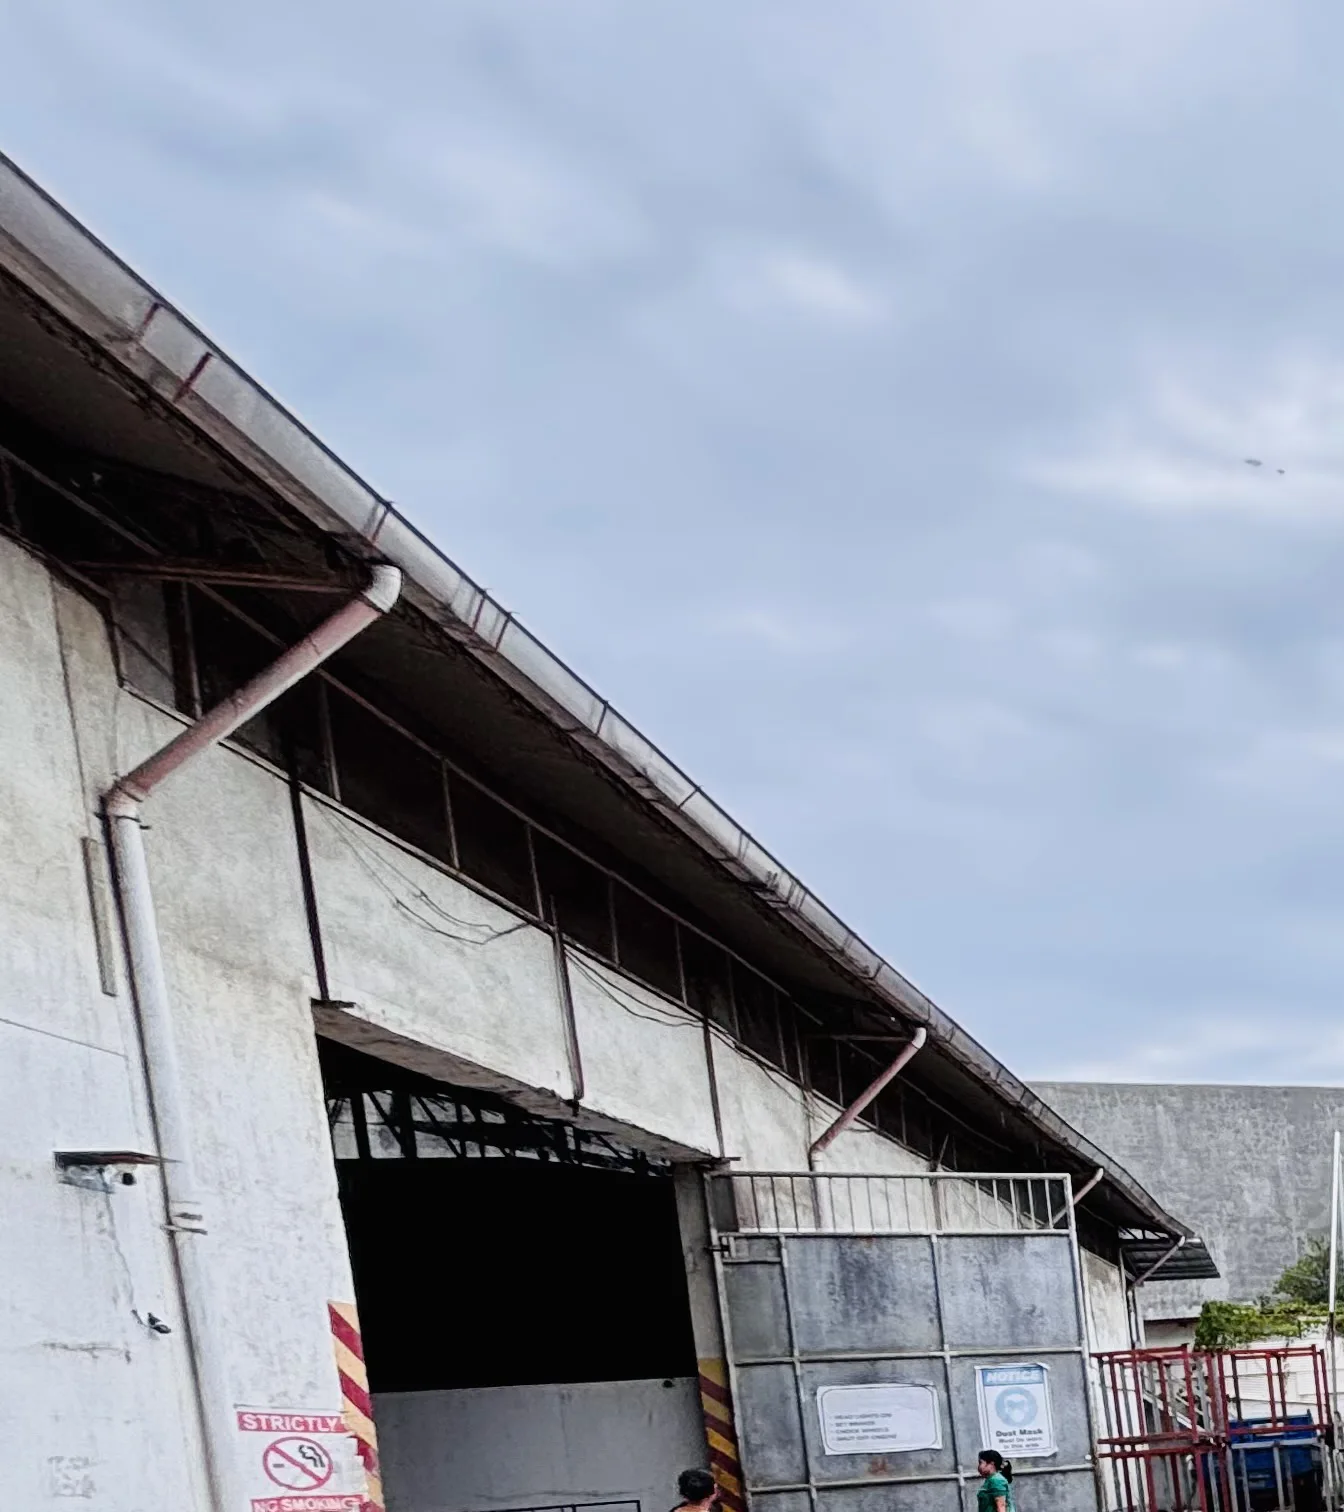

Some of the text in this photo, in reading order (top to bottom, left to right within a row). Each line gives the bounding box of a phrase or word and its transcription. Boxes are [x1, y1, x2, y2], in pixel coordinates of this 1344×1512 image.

[986, 1370, 1040, 1383] NOTICE
[242, 1413, 338, 1432] STRICTLY
[1020, 1428, 1043, 1436] Mask
[282, 1497, 358, 1512] SMOKING
